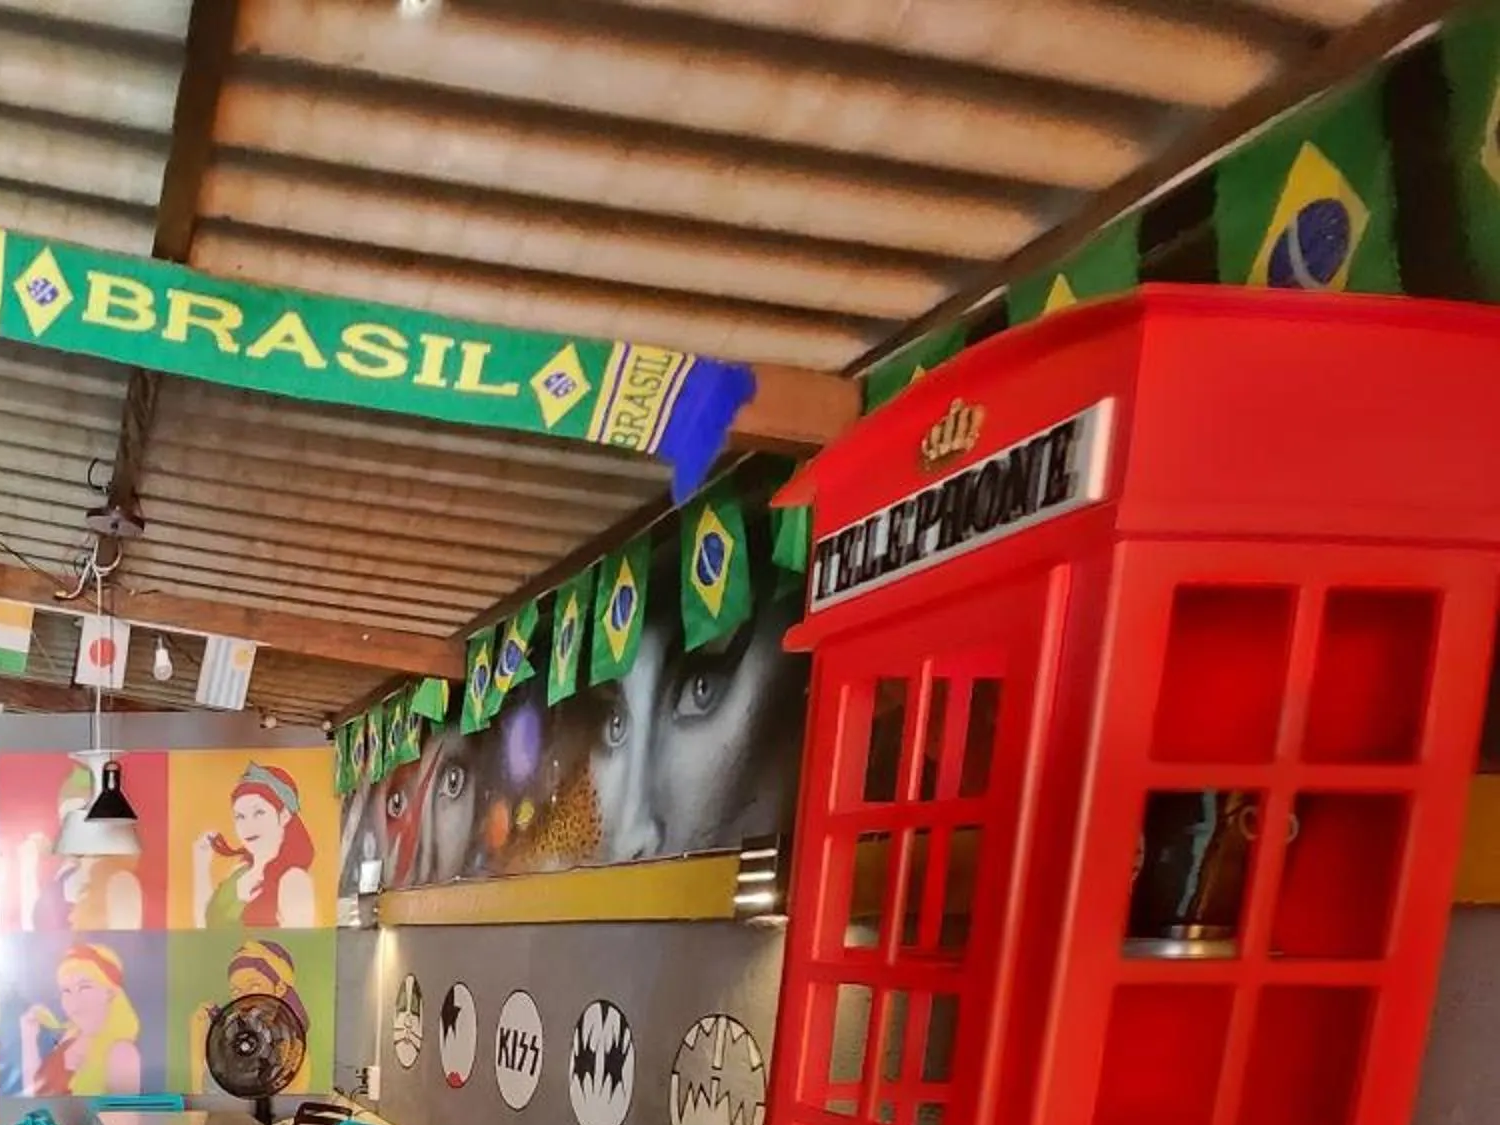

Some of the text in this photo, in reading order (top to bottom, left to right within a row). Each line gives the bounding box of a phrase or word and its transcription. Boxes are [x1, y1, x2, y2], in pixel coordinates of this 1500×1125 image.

[82, 271, 519, 396] BRASIL
[609, 354, 673, 448] BRASIL
[815, 420, 1077, 600] TELEPHONE
[498, 1027, 540, 1077] KISS
